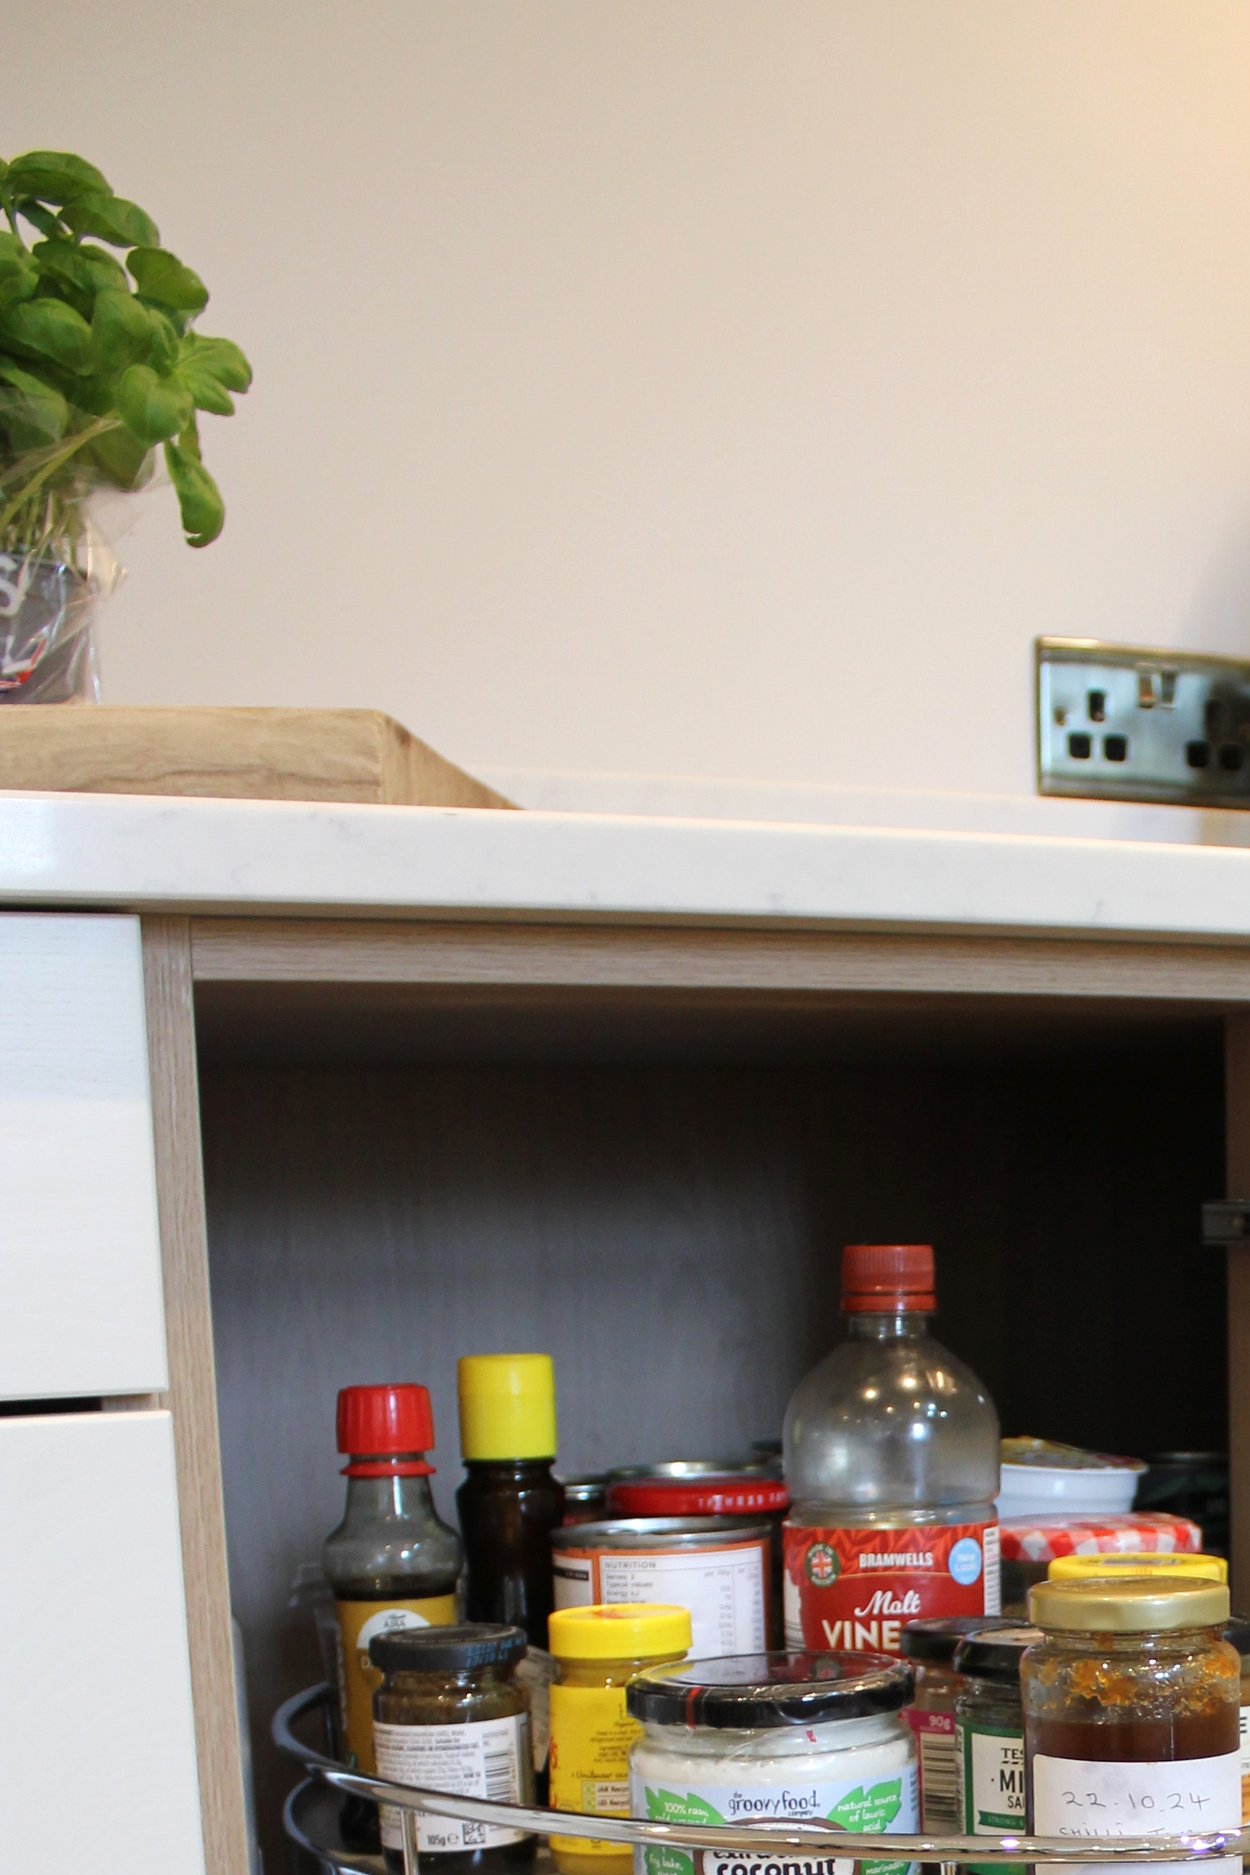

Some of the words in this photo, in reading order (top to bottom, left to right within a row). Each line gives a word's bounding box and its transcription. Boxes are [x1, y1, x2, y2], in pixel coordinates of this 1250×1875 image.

[604, 1561, 657, 1569] NUTRITION
[859, 1552, 934, 1569] BRAMWELLS
[854, 1589, 921, 1618] Malt
[821, 1619, 901, 1651] VINE
[928, 1715, 951, 1731] 90g
[1000, 1747, 1025, 1760] TES
[1000, 1769, 1024, 1794] MI
[664, 1802, 687, 1815] 100%
[838, 1795, 873, 1812] natural
[849, 1809, 860, 1823] of
